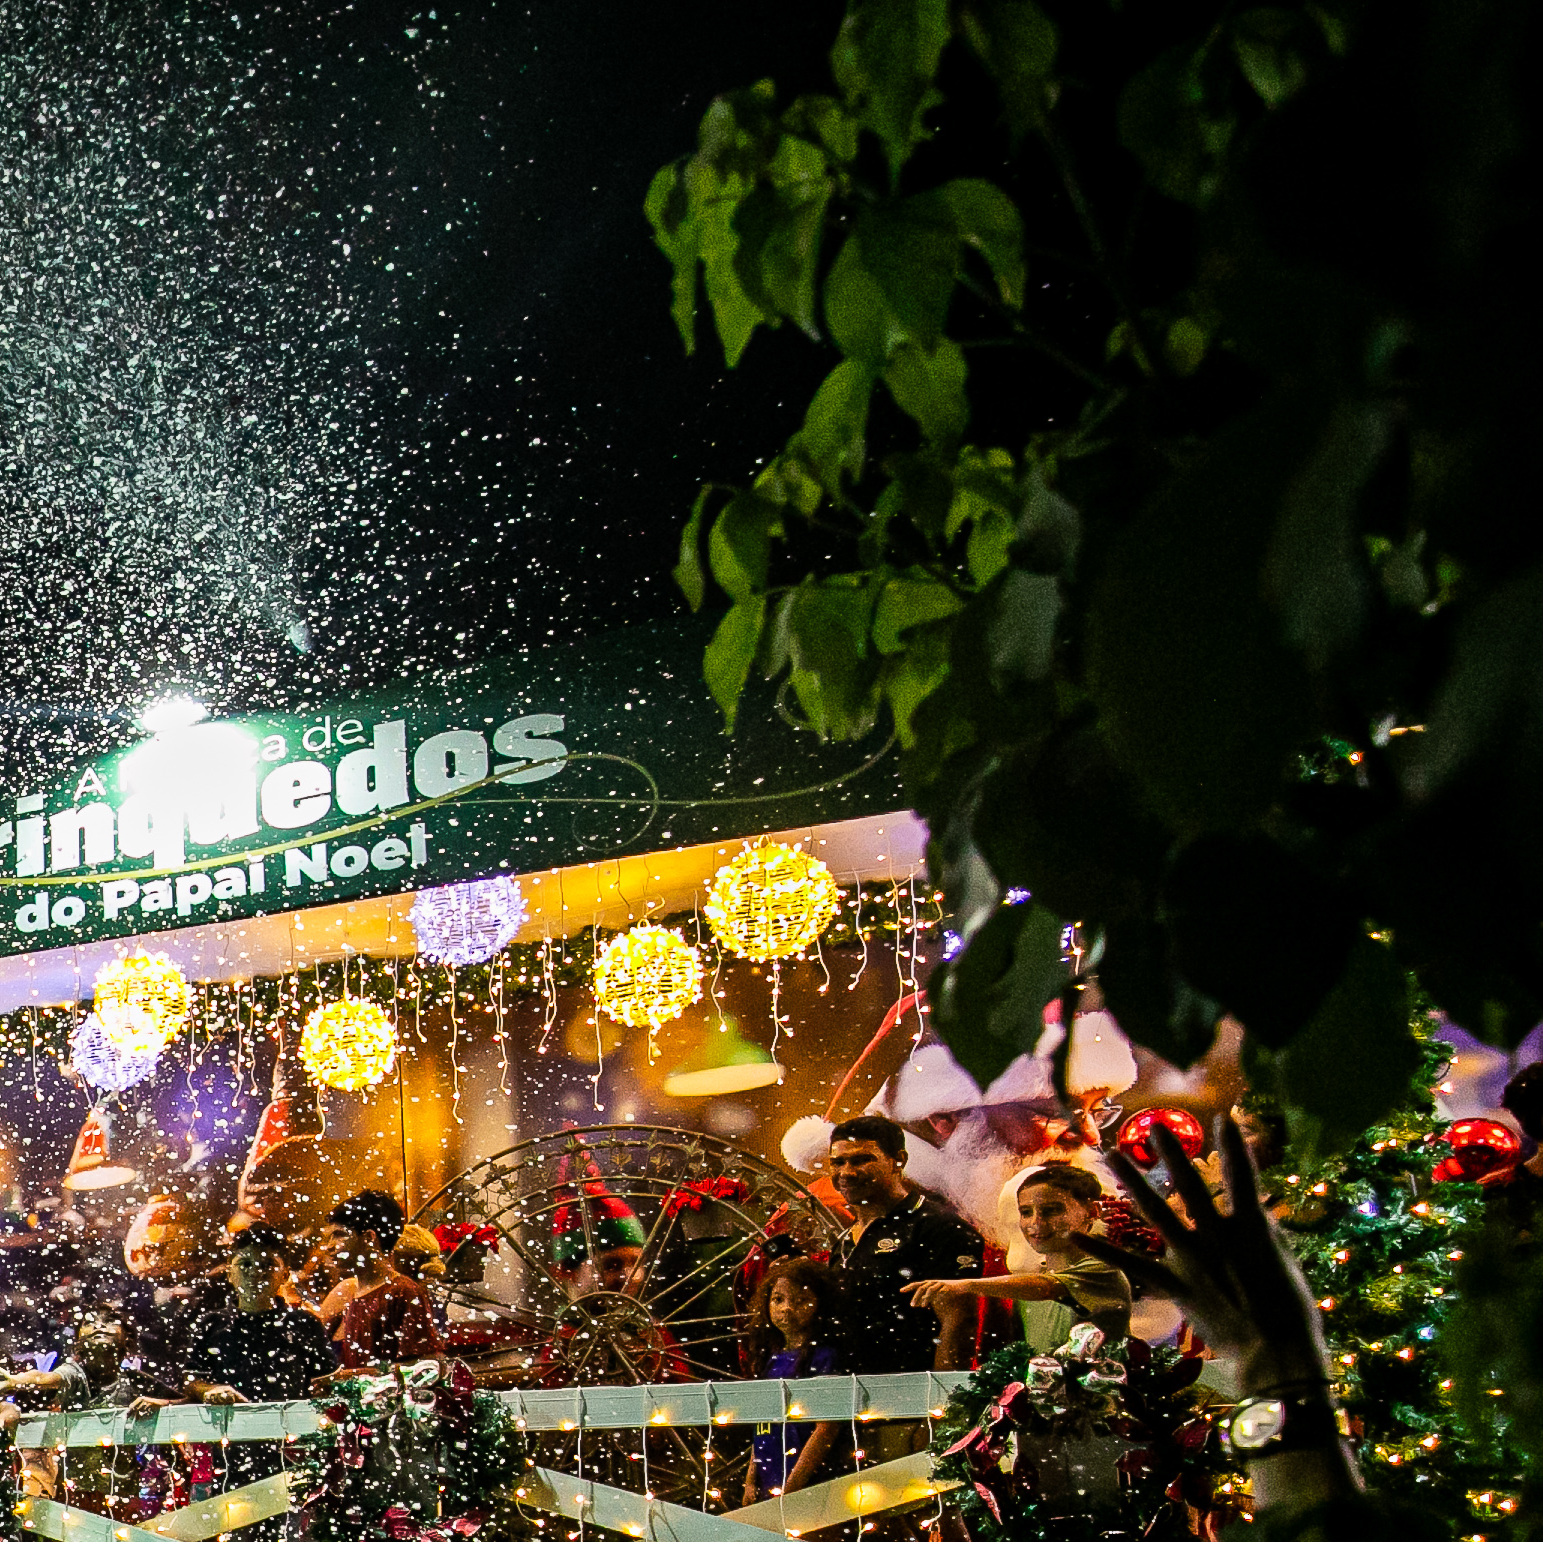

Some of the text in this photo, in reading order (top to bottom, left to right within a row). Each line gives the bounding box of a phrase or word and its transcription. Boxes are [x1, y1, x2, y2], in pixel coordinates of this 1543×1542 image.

[74, 715, 364, 801] A de
[16, 823, 427, 933] do Papai Noel
